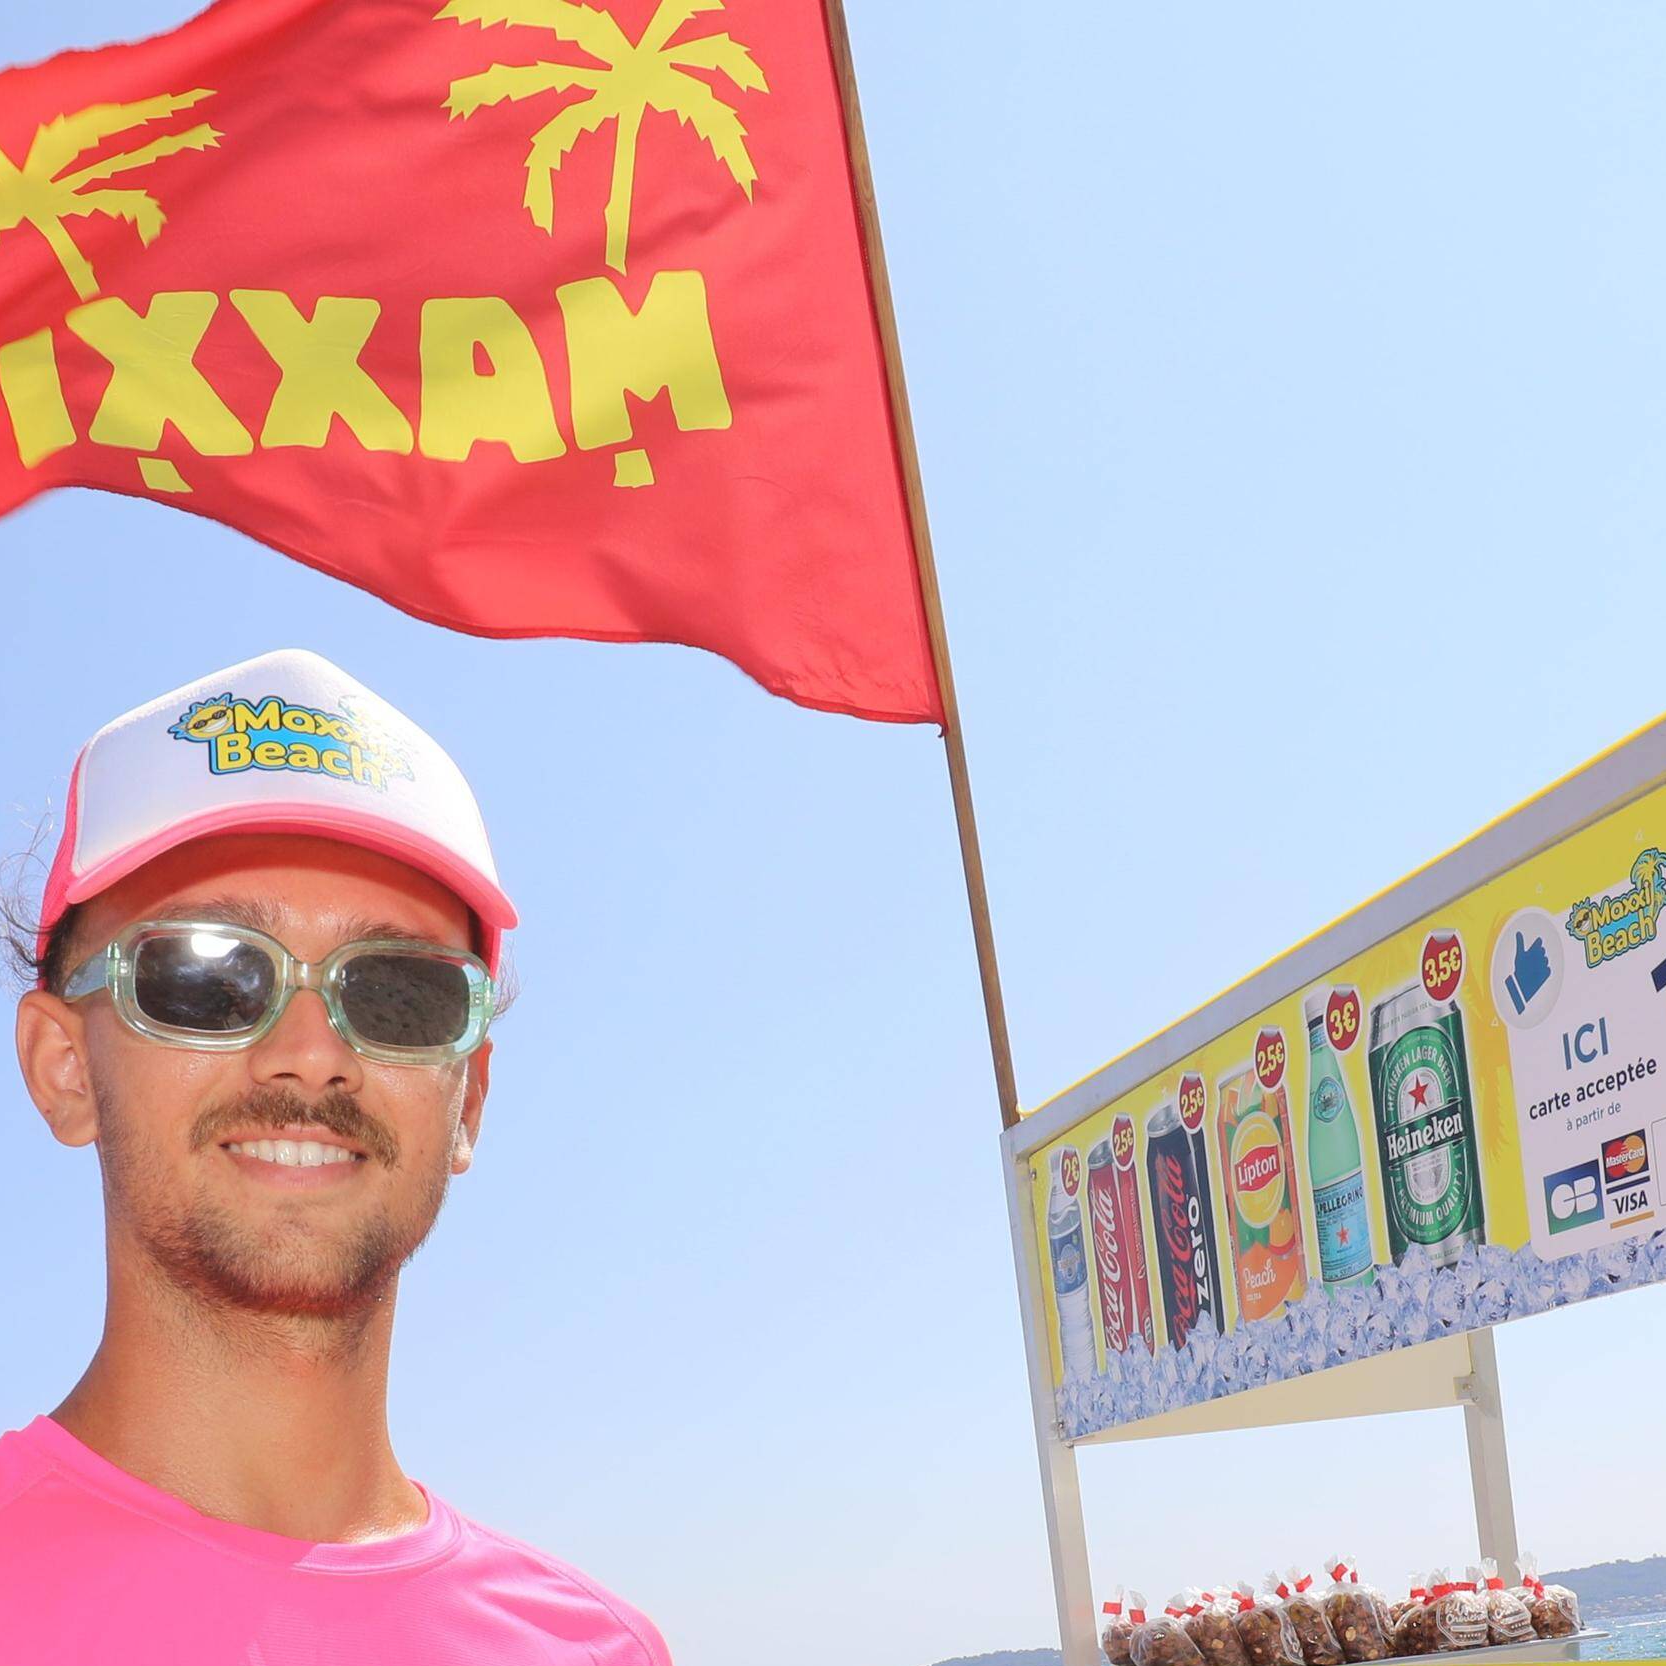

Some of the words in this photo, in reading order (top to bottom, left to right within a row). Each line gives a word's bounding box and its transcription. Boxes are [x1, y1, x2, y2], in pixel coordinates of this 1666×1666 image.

[216, 732, 383, 789] Beach
[1592, 881, 1651, 930] Maxxi
[1586, 913, 1655, 964] Beach
[1329, 1002, 1356, 1042] 3€
[1562, 1017, 1609, 1070] ICI
[1411, 1047, 1437, 1064] LAGER
[1436, 1054, 1452, 1088] BEER
[1528, 1087, 1571, 1121] carte
[1576, 1057, 1658, 1102] acceptée
[1386, 1111, 1464, 1162] Heineken
[1576, 1104, 1605, 1130] partir
[1607, 1100, 1622, 1117] de
[1237, 1152, 1278, 1186] Lipton
[1611, 1191, 1649, 1215] VISA
[1188, 1196, 1210, 1305] zero
[1244, 1260, 1276, 1289] Peach
